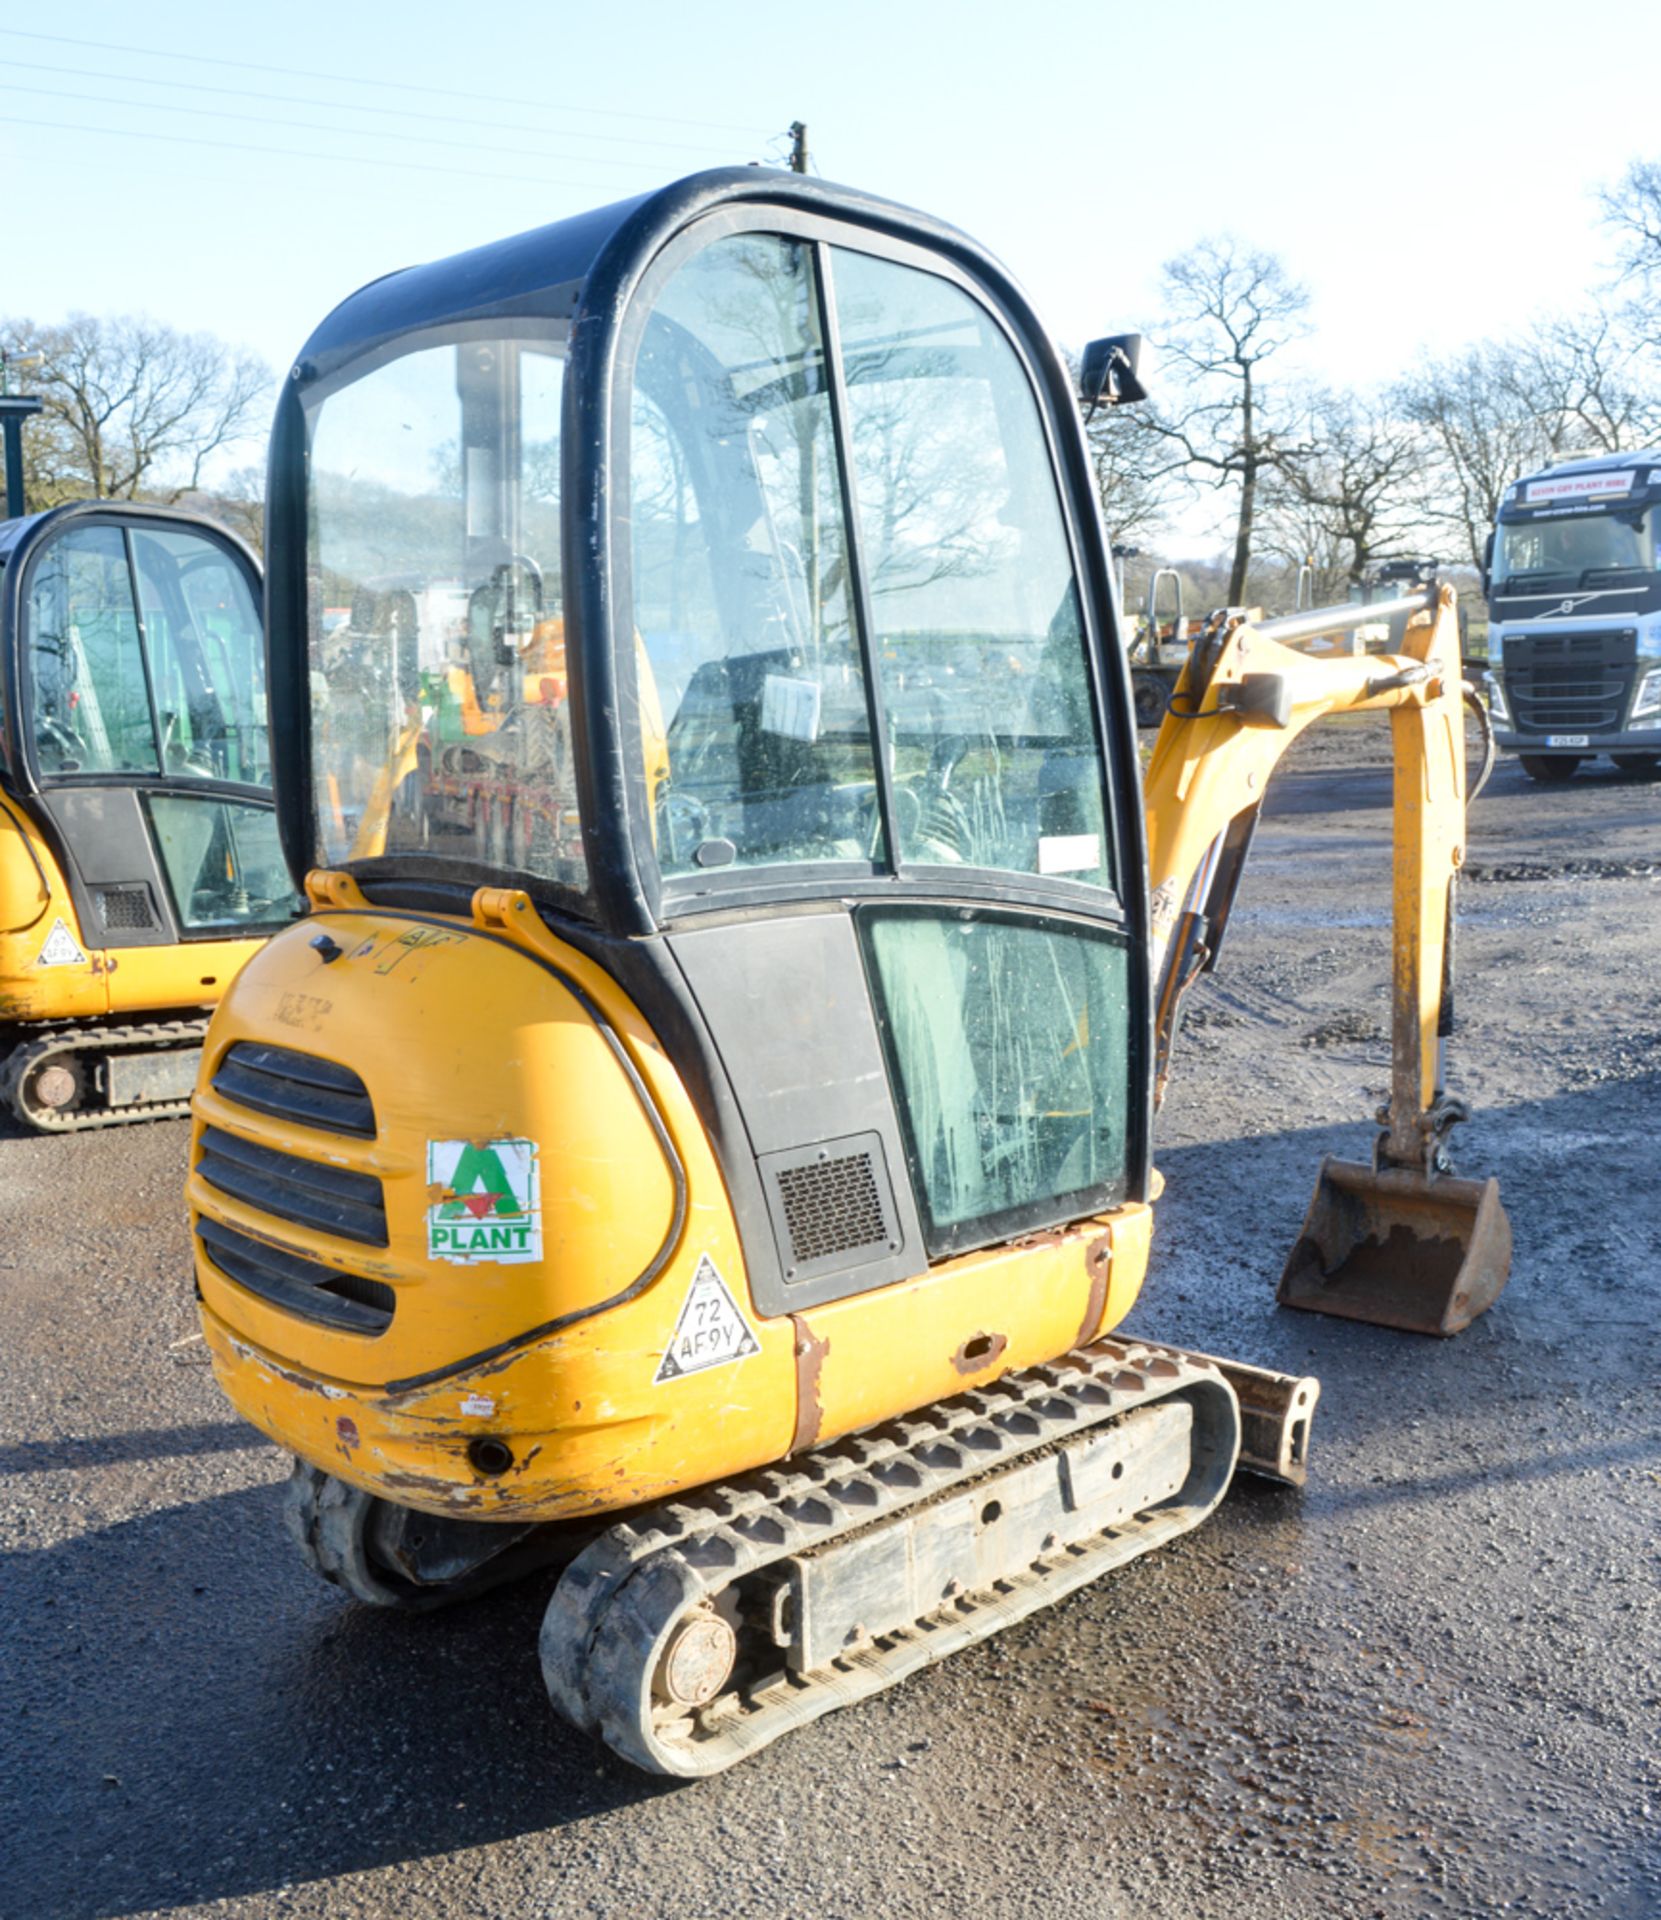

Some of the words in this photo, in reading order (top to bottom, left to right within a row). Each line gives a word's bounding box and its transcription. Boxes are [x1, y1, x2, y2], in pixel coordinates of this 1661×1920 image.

[1574, 480, 1602, 492] PLANT
[437, 1143, 526, 1220] A
[431, 1227, 532, 1249] PLANT
[695, 1298, 721, 1326] 72
[680, 1322, 735, 1359] AF9Y
